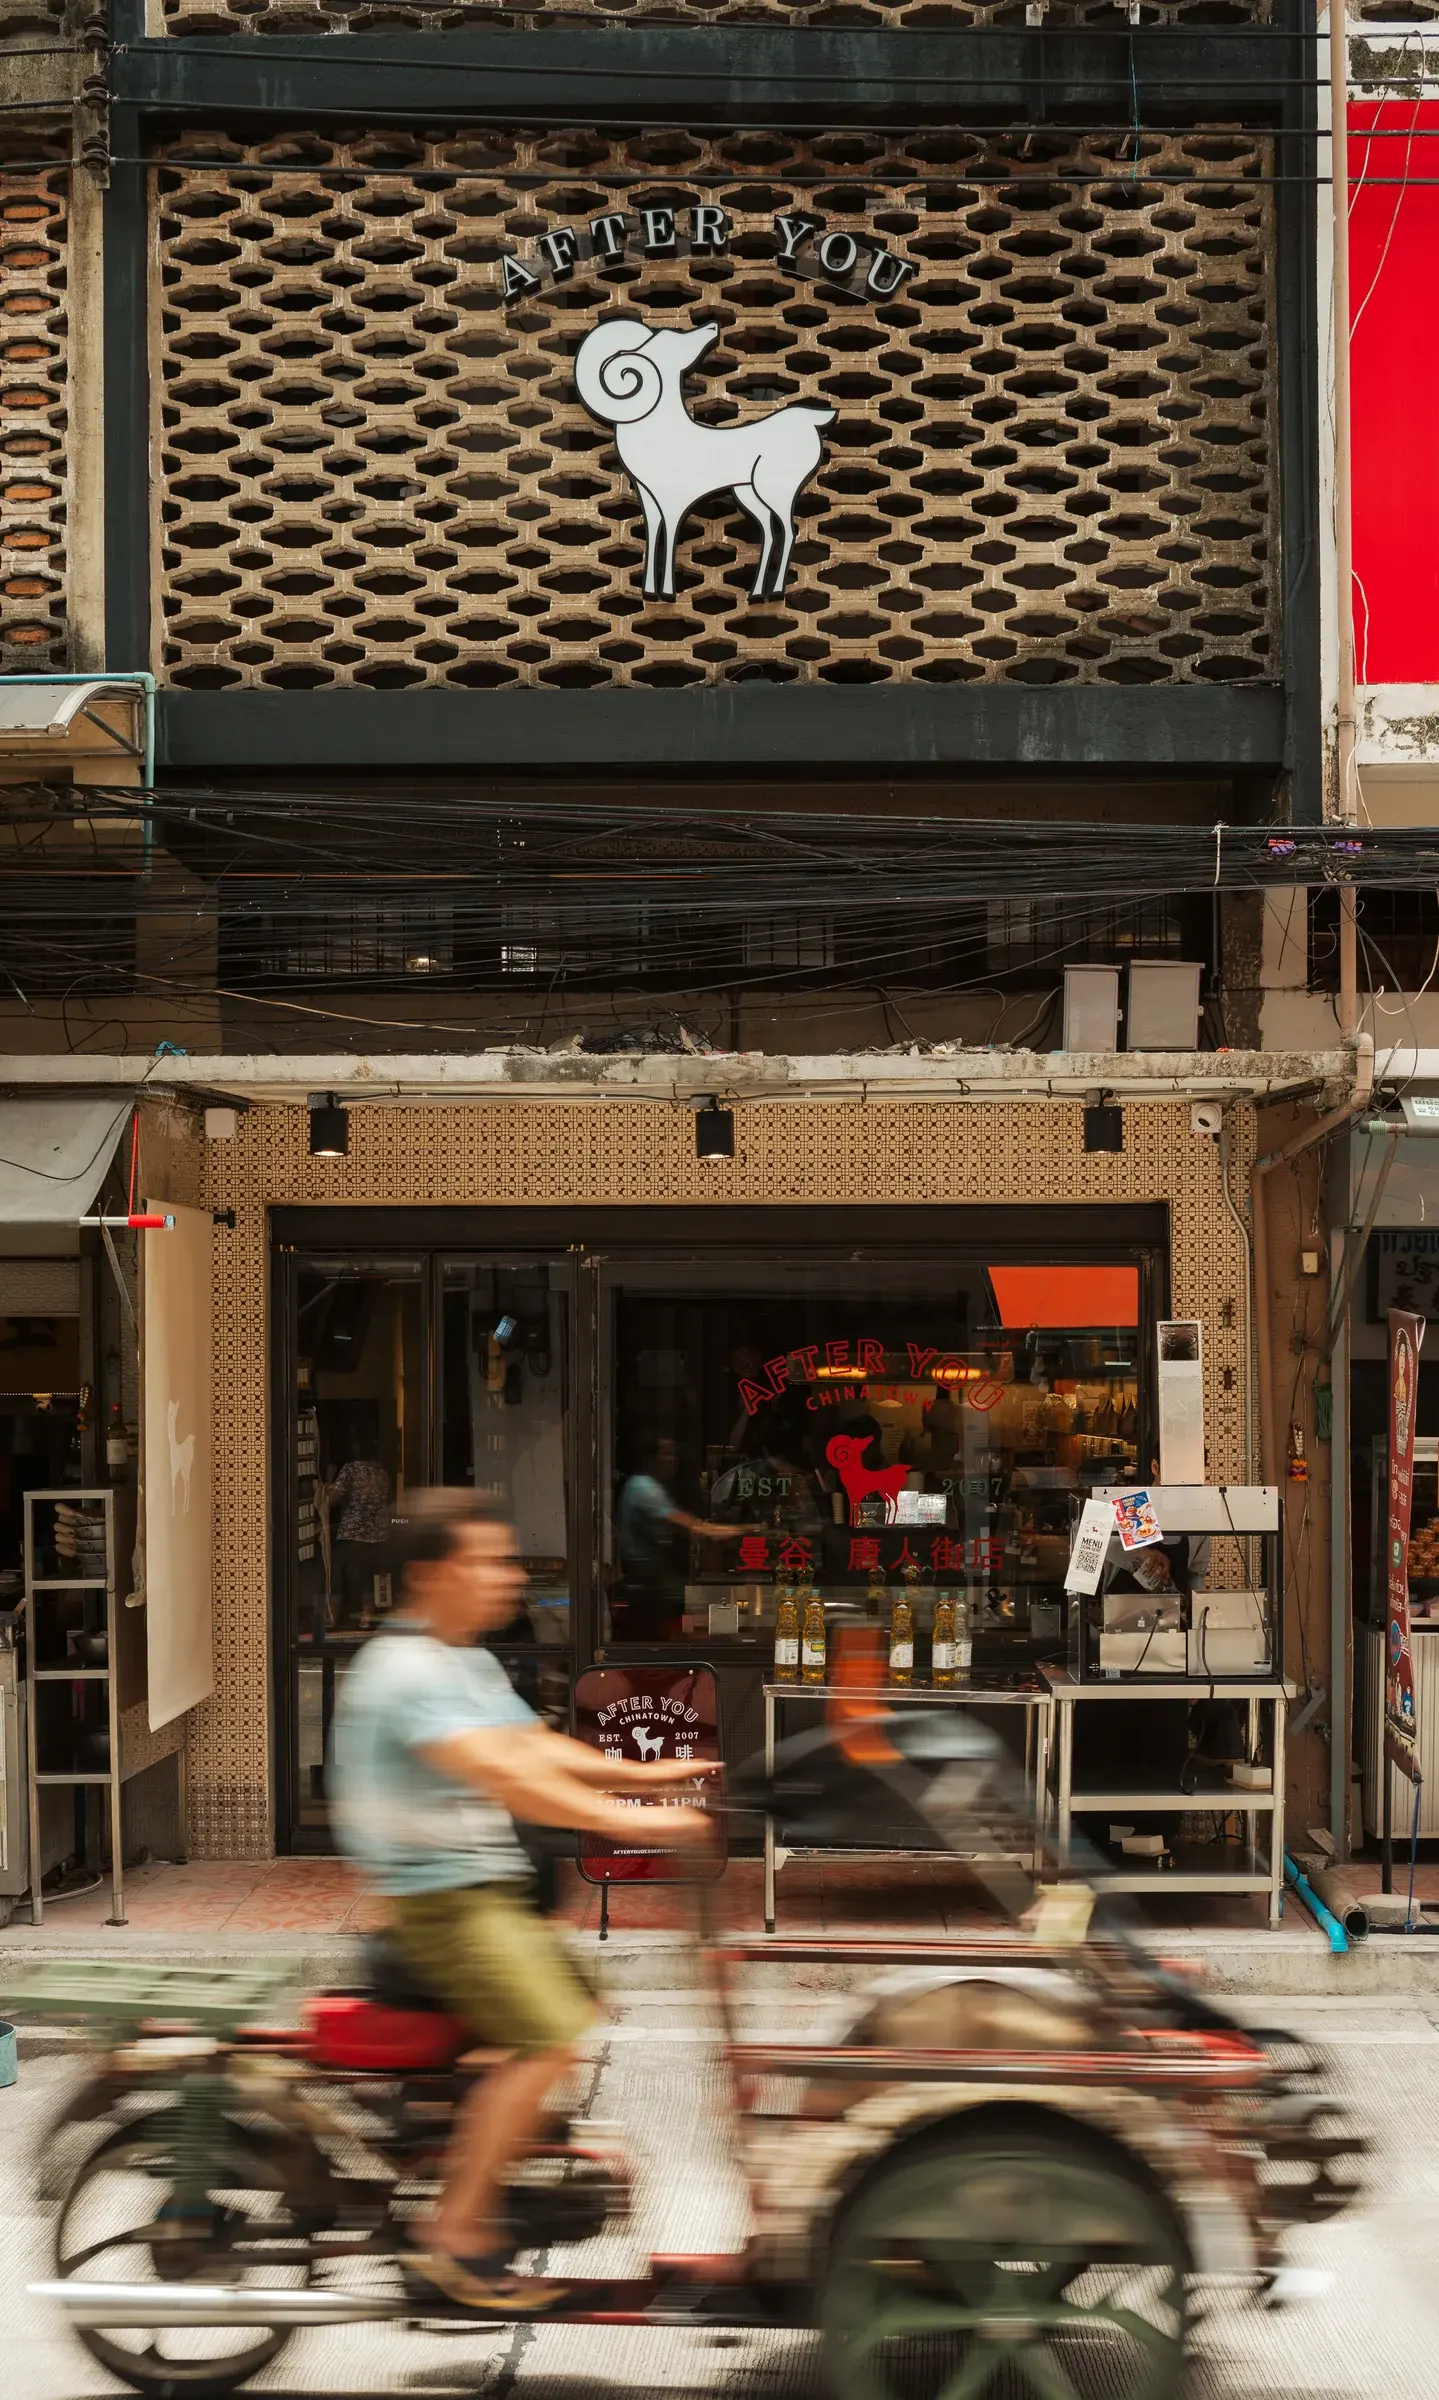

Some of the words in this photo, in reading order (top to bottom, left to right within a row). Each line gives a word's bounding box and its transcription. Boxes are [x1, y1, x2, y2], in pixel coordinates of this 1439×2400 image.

[501, 205, 728, 297] AFTER
[774, 215, 913, 294] YOU
[738, 1339, 885, 1415] AFTER
[906, 1342, 1005, 1412] YOU
[806, 1384, 933, 1413] CHINATOWN
[737, 1477, 799, 1498] EST.
[942, 1478, 1003, 1497] 2007
[737, 1536, 813, 1571] 曼谷
[847, 1535, 1006, 1571] 唐人街店
[1082, 1537, 1103, 1549] MENU
[597, 1696, 653, 1726] AFTER
[660, 1696, 698, 1723] YOU
[619, 1712, 675, 1725] CHINATOWN
[599, 1733, 623, 1742] EST.
[675, 1732, 699, 1740] 2007
[605, 1746, 623, 1763] 咖
[675, 1744, 694, 1762] 啡
[660, 1797, 706, 1808] 11PM
